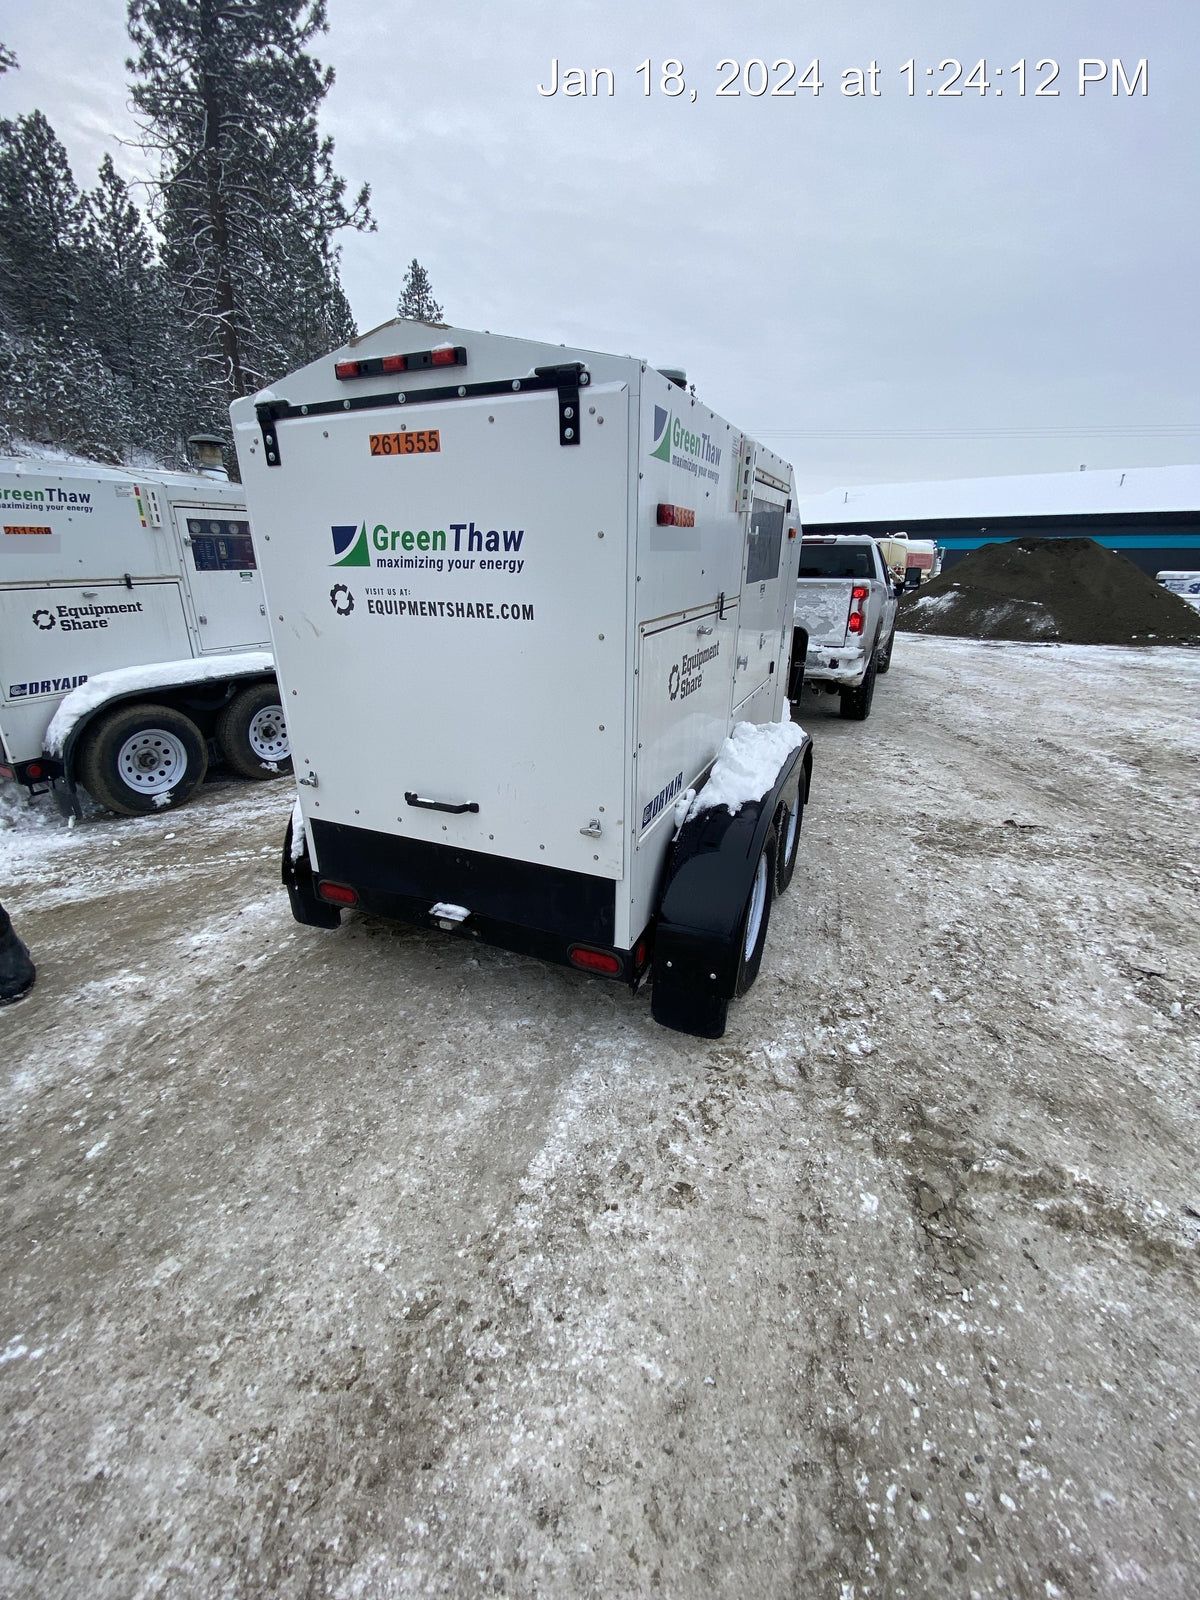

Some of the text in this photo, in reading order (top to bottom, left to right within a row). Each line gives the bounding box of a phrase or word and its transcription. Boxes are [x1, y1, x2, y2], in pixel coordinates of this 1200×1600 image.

[371, 431, 438, 456] 261555
[672, 454, 720, 485] maximizing your energy
[0, 488, 91, 503] reenThaw
[376, 555, 525, 574] maximizing your energy
[387, 588, 397, 596] US
[399, 588, 411, 596] AT:
[56, 601, 143, 618] Equipment
[367, 599, 534, 621] EQUIPMENTSHARE.COM
[60, 618, 109, 631] Share
[681, 640, 720, 676] Equipment
[29, 674, 88, 695] DRYAIR
[680, 673, 703, 700] Share
[652, 771, 683, 819] DRYAIR
